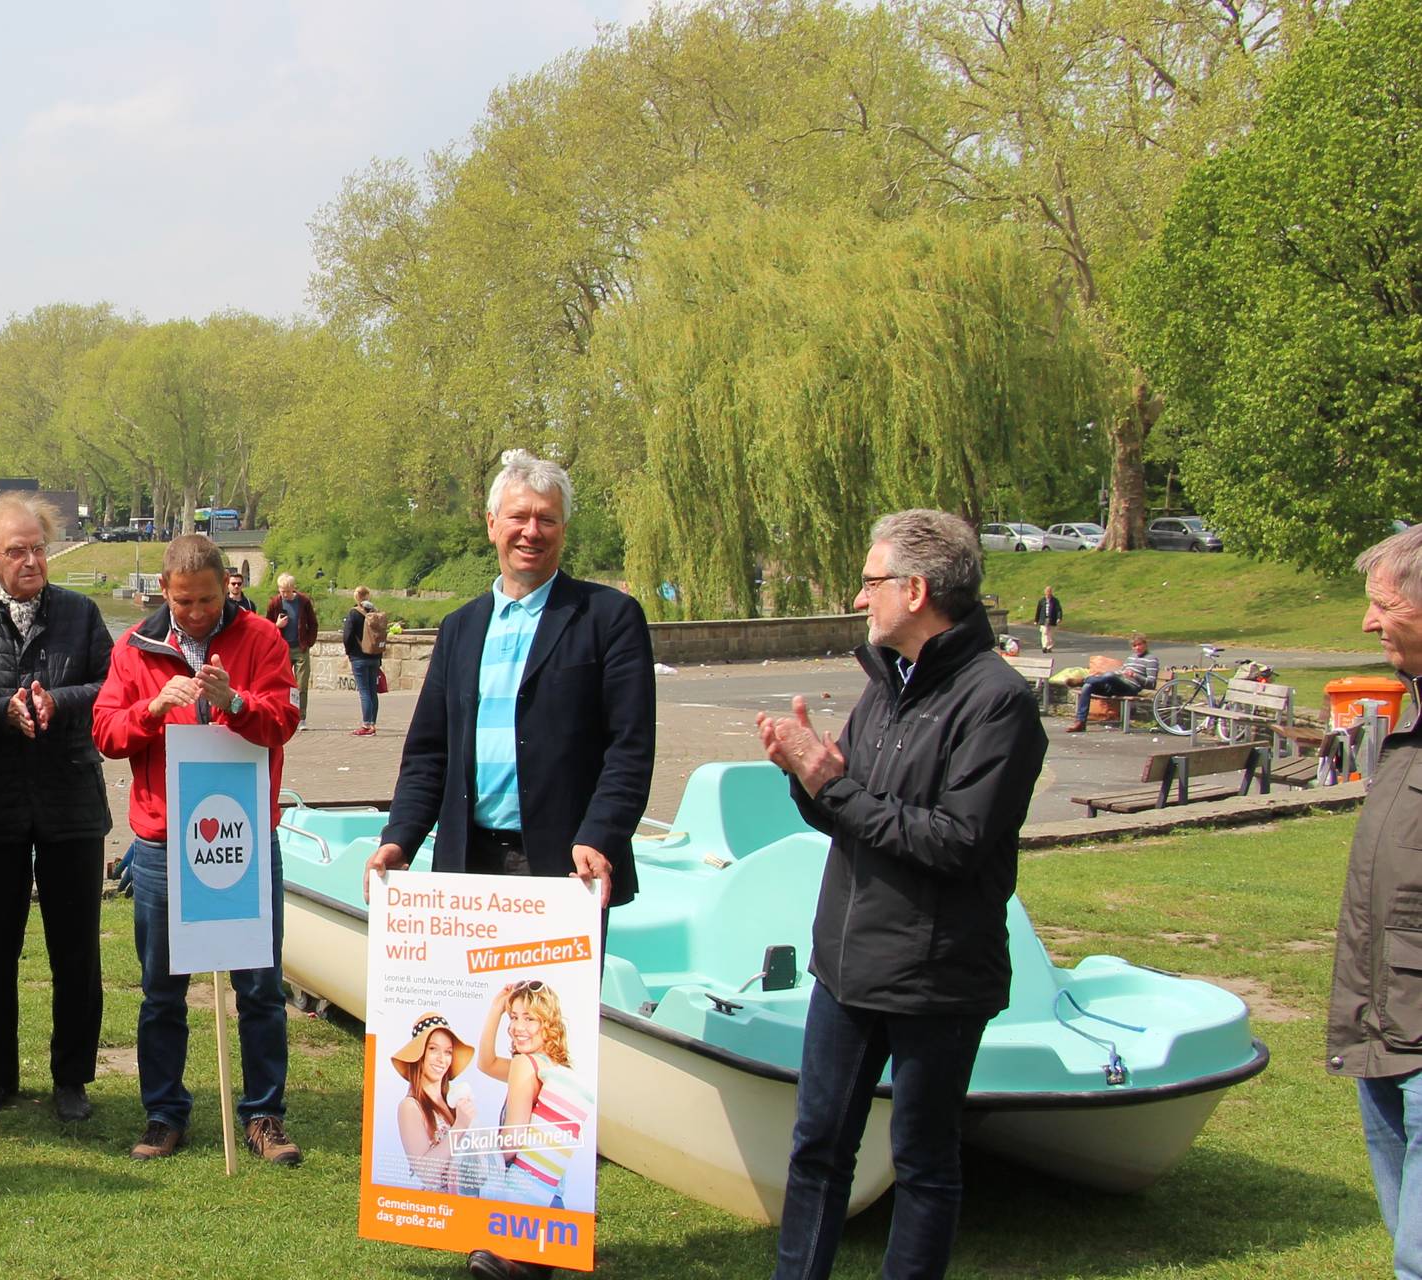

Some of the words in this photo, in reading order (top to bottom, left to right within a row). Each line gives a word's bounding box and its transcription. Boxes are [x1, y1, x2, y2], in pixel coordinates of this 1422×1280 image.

[194, 822, 198, 839] I
[220, 822, 243, 838] MY
[194, 847, 243, 865] AASEE
[387, 887, 445, 909] Damit
[450, 895, 483, 911] aus
[487, 893, 546, 914] Aasee
[386, 912, 424, 934] kein
[430, 916, 498, 939] Bähsee
[386, 941, 427, 961] wird
[470, 951, 501, 970] Wir
[427, 977, 455, 986] Marlene
[465, 980, 489, 989] nutzen
[433, 989, 447, 997] und
[447, 988, 484, 1000] Grillstellen
[377, 1196, 436, 1215] Gemeinsam
[438, 1203, 454, 1217] für
[376, 1211, 394, 1223] das
[396, 1214, 425, 1227] große
[427, 1217, 446, 1230] Ziel
